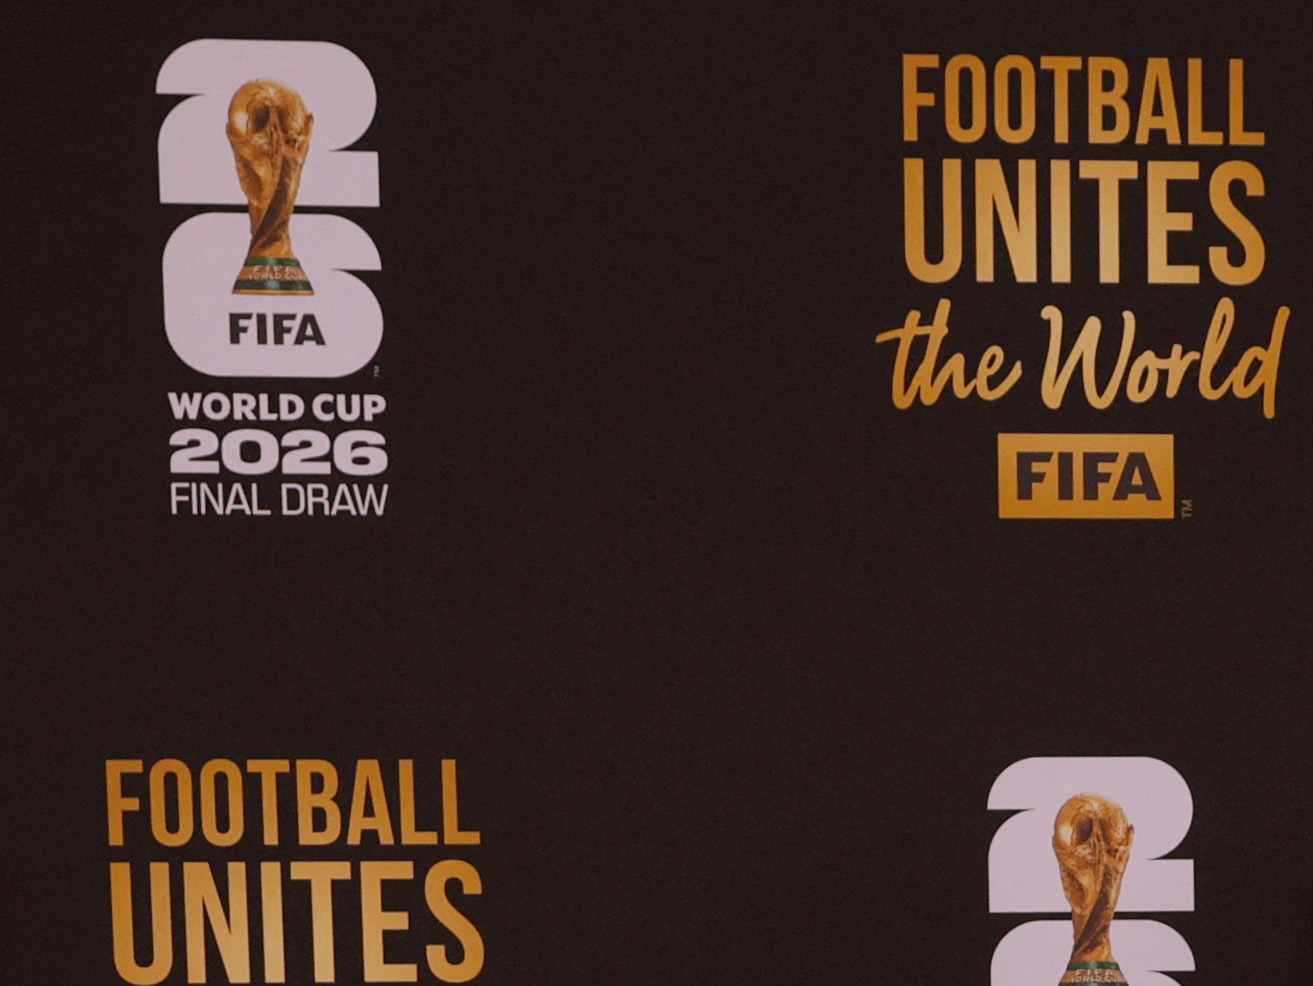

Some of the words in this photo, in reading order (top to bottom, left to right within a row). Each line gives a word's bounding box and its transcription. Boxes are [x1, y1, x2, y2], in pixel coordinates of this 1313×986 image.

[903, 54, 1264, 145] FOOTBALL
[904, 158, 1265, 285] UNITES
[229, 313, 325, 345] FIFA
[876, 299, 1022, 409] the
[1041, 297, 1290, 418] World
[168, 392, 304, 420] WORLD
[312, 394, 386, 421] CUP
[170, 429, 387, 475] 2026
[1017, 452, 1161, 500] FIFA
[171, 483, 271, 515] FINAL
[282, 483, 388, 515] DRAW
[106, 759, 480, 846] FOOTBALL
[110, 860, 484, 985] UNITES
